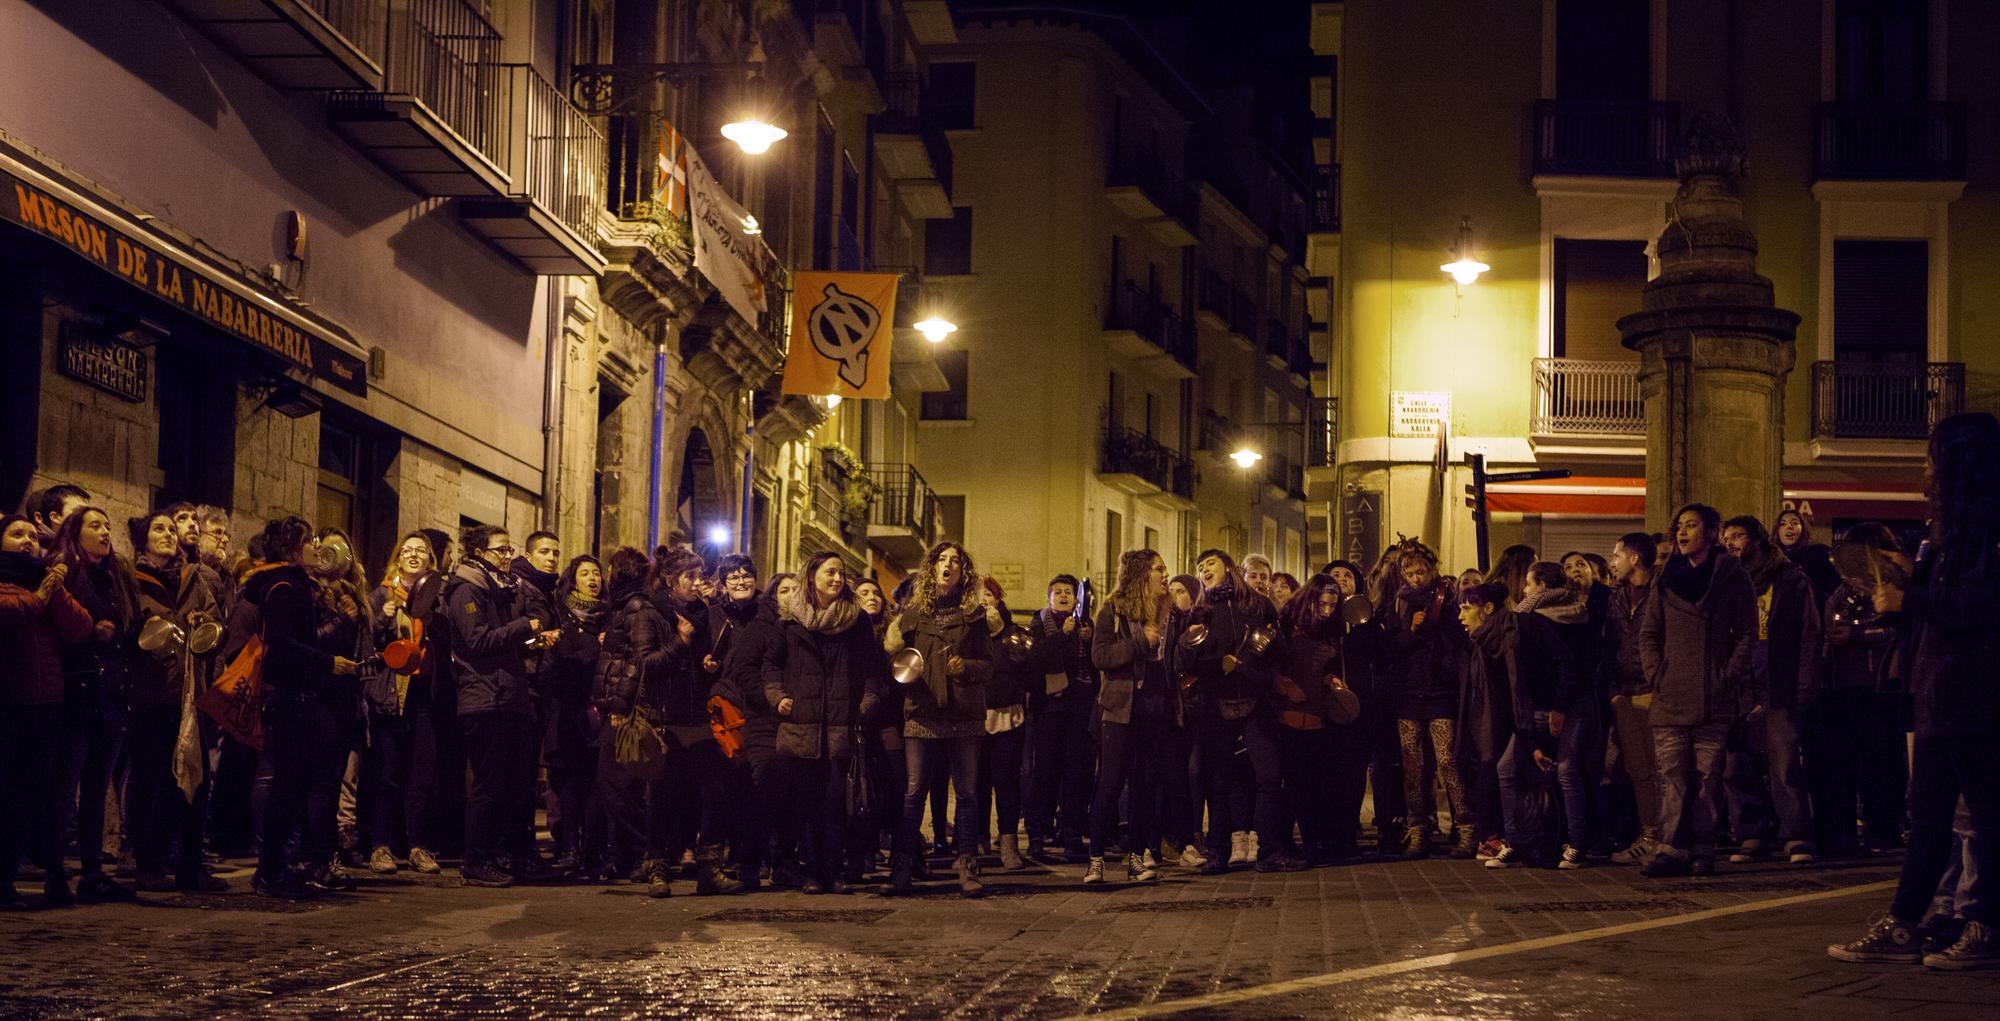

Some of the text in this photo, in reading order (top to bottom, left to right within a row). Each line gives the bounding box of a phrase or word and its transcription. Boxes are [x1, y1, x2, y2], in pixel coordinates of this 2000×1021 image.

[15, 183, 314, 370] MESON DE LA NABARRERIA
[1344, 496, 1374, 515] LA
